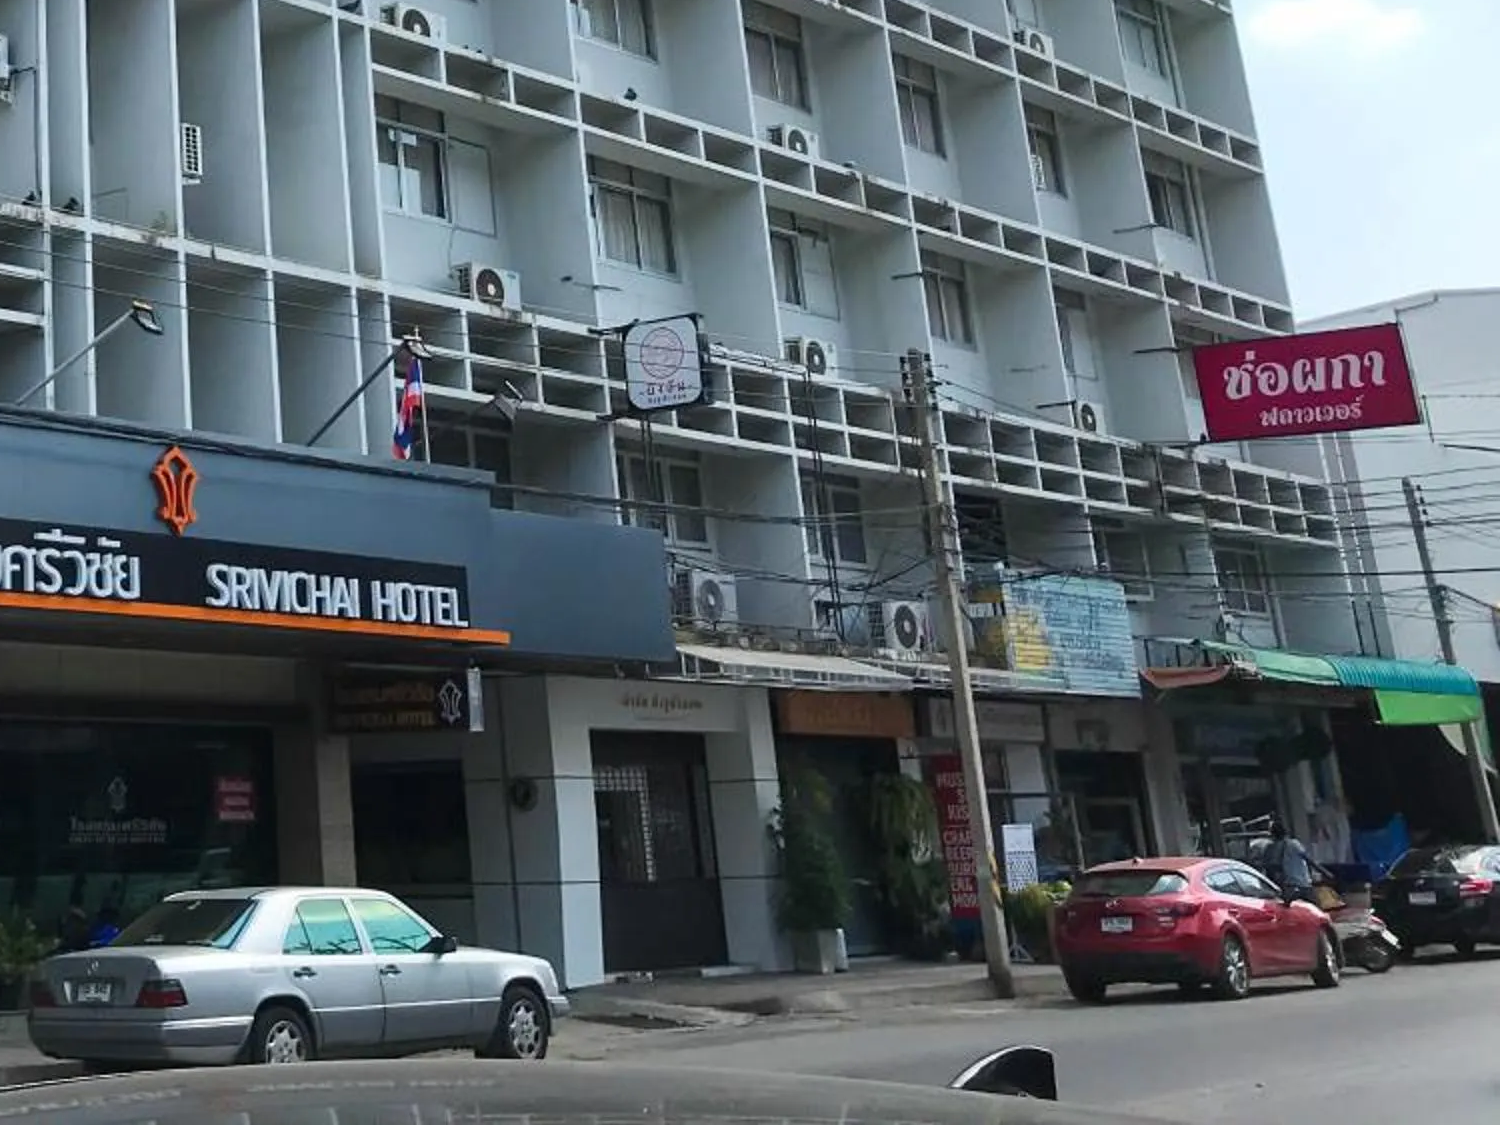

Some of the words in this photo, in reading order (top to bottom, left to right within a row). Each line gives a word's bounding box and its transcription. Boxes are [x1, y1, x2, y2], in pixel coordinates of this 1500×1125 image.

[1223, 349, 1387, 401] ช่อผกา
[1260, 394, 1365, 427] ฟลาวเวอร์
[205, 562, 361, 619] SRIVICHAI
[370, 579, 469, 628] HOTEL
